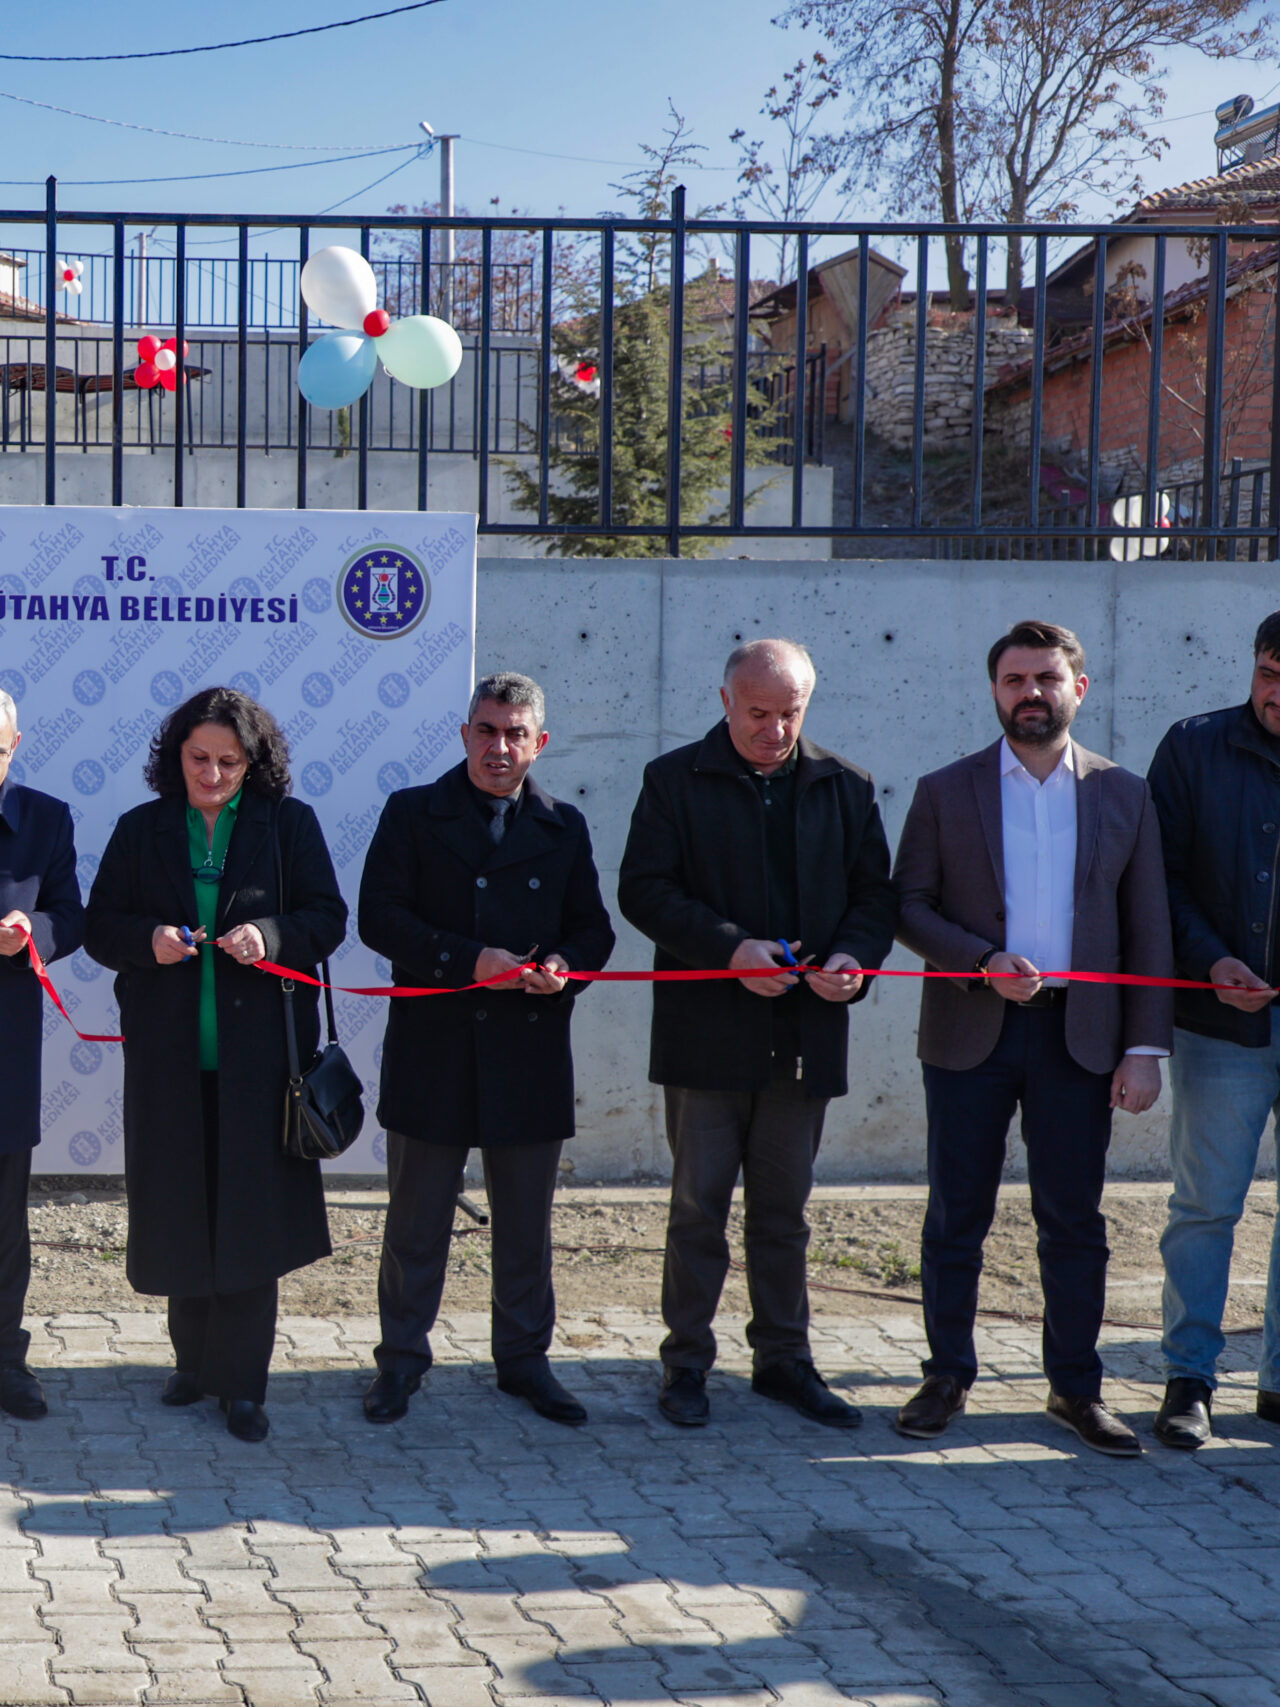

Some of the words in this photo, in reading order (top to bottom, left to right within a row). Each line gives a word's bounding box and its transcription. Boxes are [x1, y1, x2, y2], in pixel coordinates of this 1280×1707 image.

[30, 531, 52, 551] T.C.
[109, 532, 131, 551] T.C.
[187, 533, 209, 553] T.C.
[264, 534, 286, 554] T.C.
[338, 534, 360, 555] T.C.
[101, 555, 155, 581] T.C.
[120, 593, 298, 623] BELEDİYESİ
[29, 626, 51, 646] T.C.
[109, 627, 131, 647] T.C.
[187, 628, 209, 648] T.C.
[264, 628, 286, 649] T.C.
[414, 630, 435, 650] T.C.
[29, 715, 52, 736] T.C.
[109, 717, 131, 736] T.C.
[337, 718, 358, 739] T.C.
[413, 719, 435, 738] T.C.
[336, 812, 358, 831] T.C.
